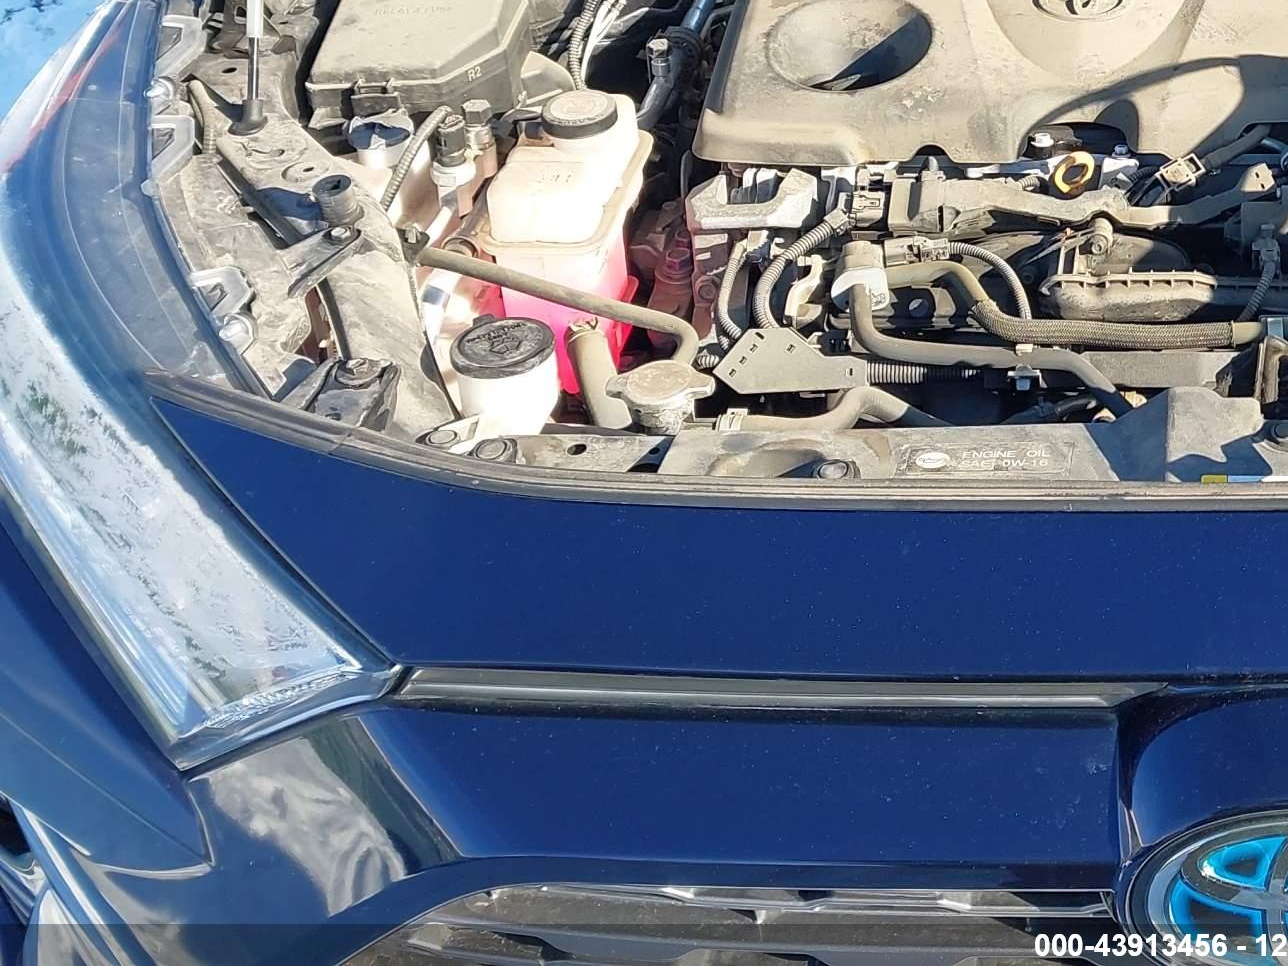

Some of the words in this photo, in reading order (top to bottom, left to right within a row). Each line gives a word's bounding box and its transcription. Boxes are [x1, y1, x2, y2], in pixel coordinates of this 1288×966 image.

[467, 65, 482, 82] R2
[962, 450, 1016, 458] ENGINE
[1026, 450, 1050, 458] OIL
[1002, 458, 1049, 467] 0W-16
